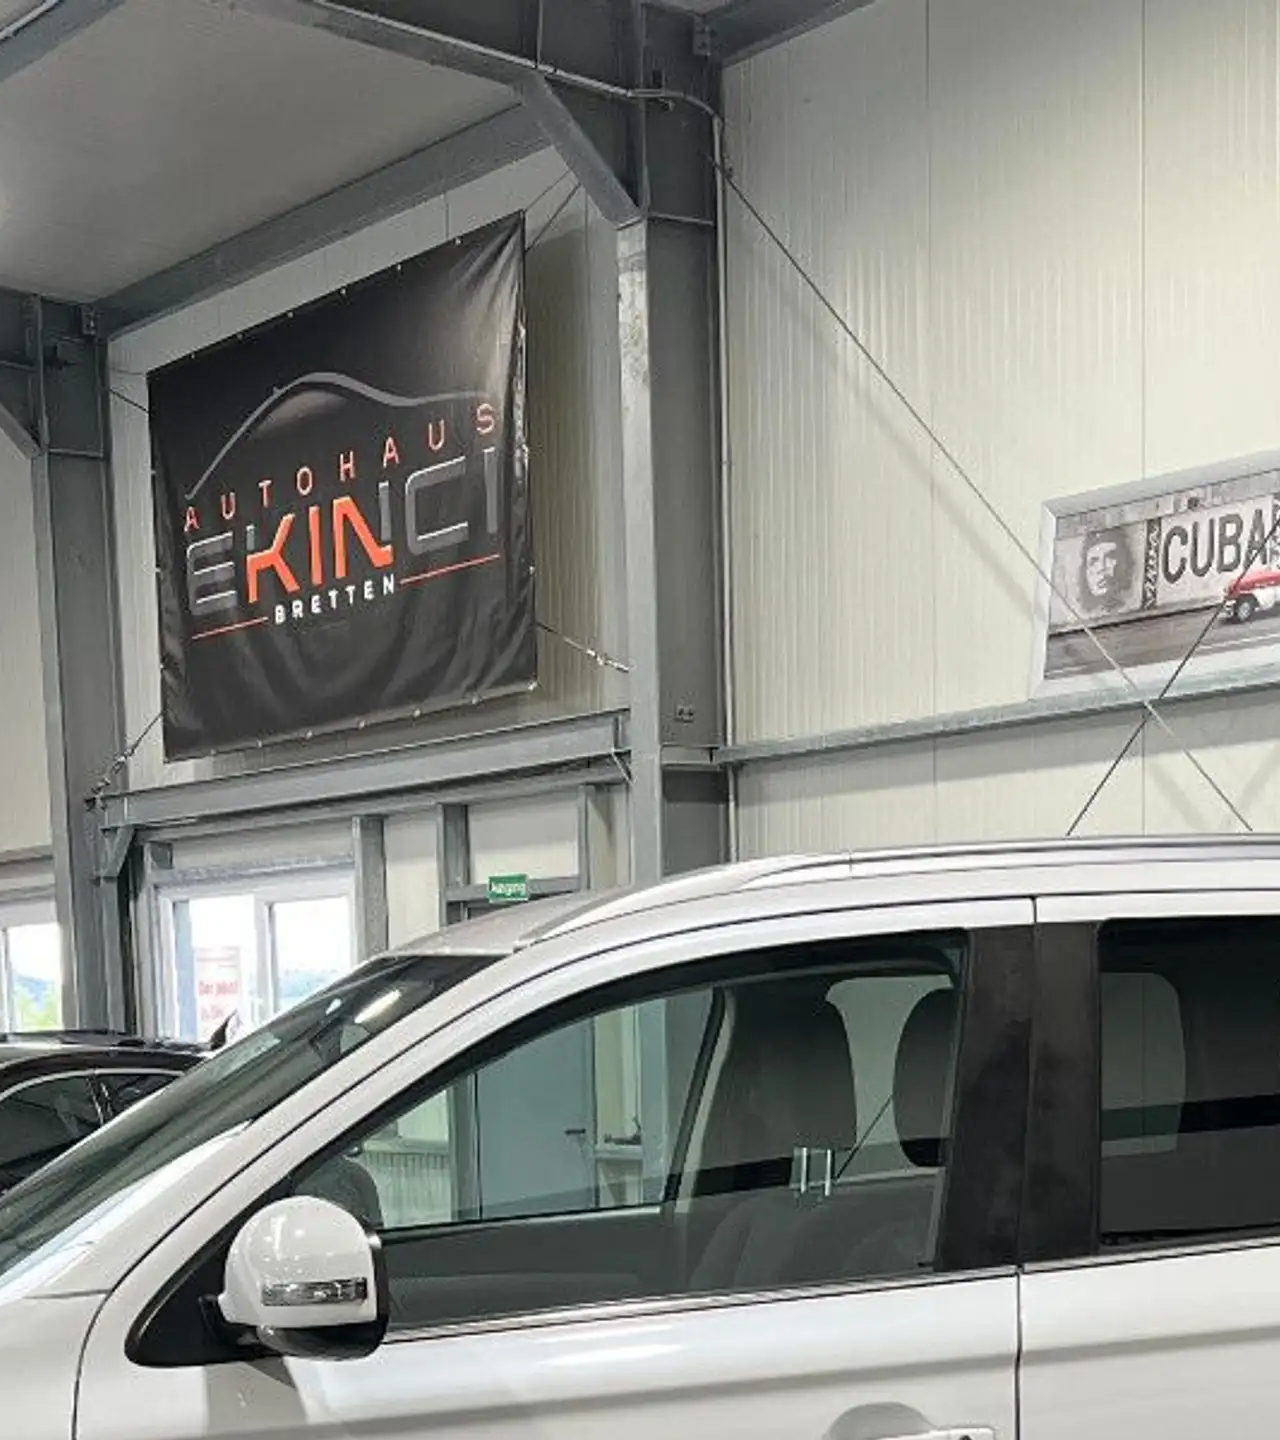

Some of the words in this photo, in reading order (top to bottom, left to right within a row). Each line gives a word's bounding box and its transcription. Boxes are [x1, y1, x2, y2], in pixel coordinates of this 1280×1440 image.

[184, 403, 496, 533] AUTOHAUS
[187, 446, 499, 616] EKINCI
[1161, 508, 1268, 585] CUBA
[275, 573, 396, 625] BRETTEN
